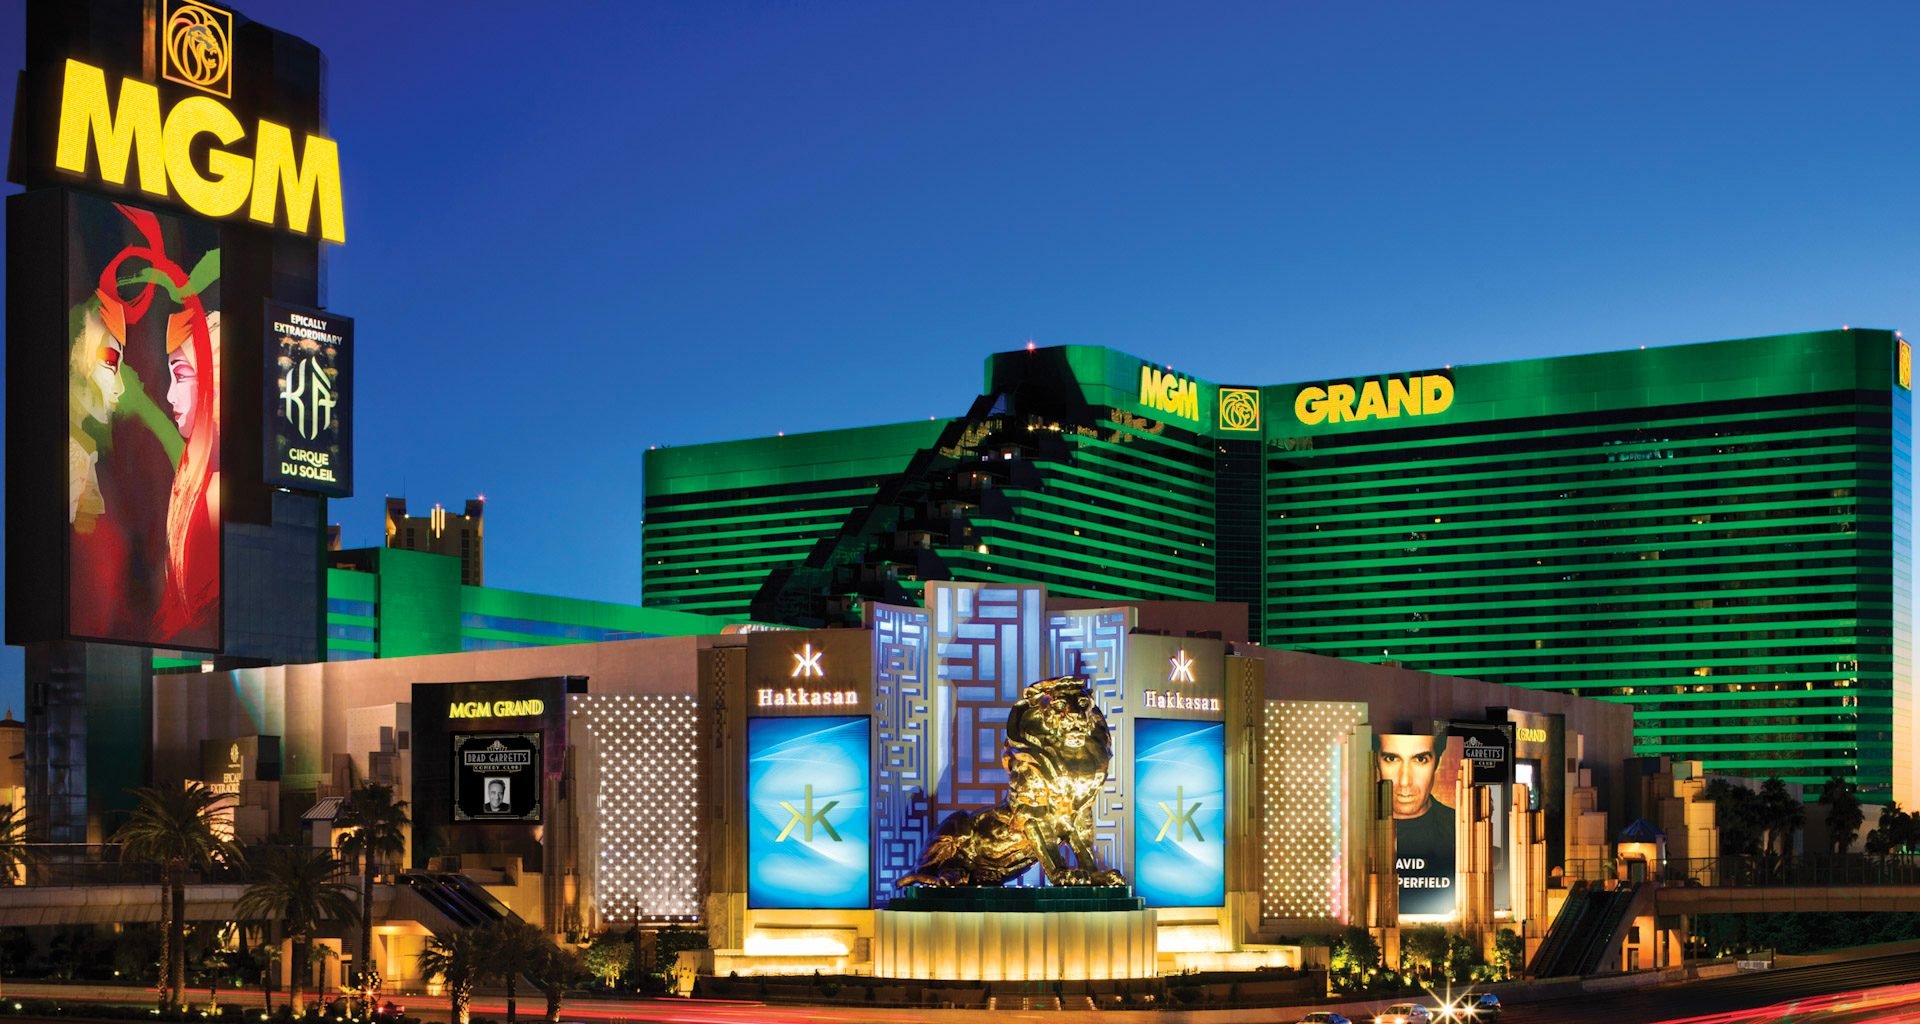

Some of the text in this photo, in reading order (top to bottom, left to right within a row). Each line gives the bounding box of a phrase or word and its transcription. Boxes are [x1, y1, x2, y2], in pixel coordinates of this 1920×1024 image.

[55, 58, 345, 243] MGM
[290, 313, 327, 331] EPICALLY
[273, 321, 342, 345] EXTRAORDINARY
[1139, 365, 1454, 426] MGM GRAND
[288, 448, 329, 467] CIRQUE
[281, 462, 336, 482] DU SOLEIL
[757, 688, 858, 706] Hakkasan
[1144, 690, 1220, 711] Hakkasan
[448, 699, 544, 718] MGM GRAND
[1520, 728, 1547, 742] GRAND
[467, 752, 527, 763] BRAD GARRETT'S
[1465, 748, 1501, 758] GARRETT'S
